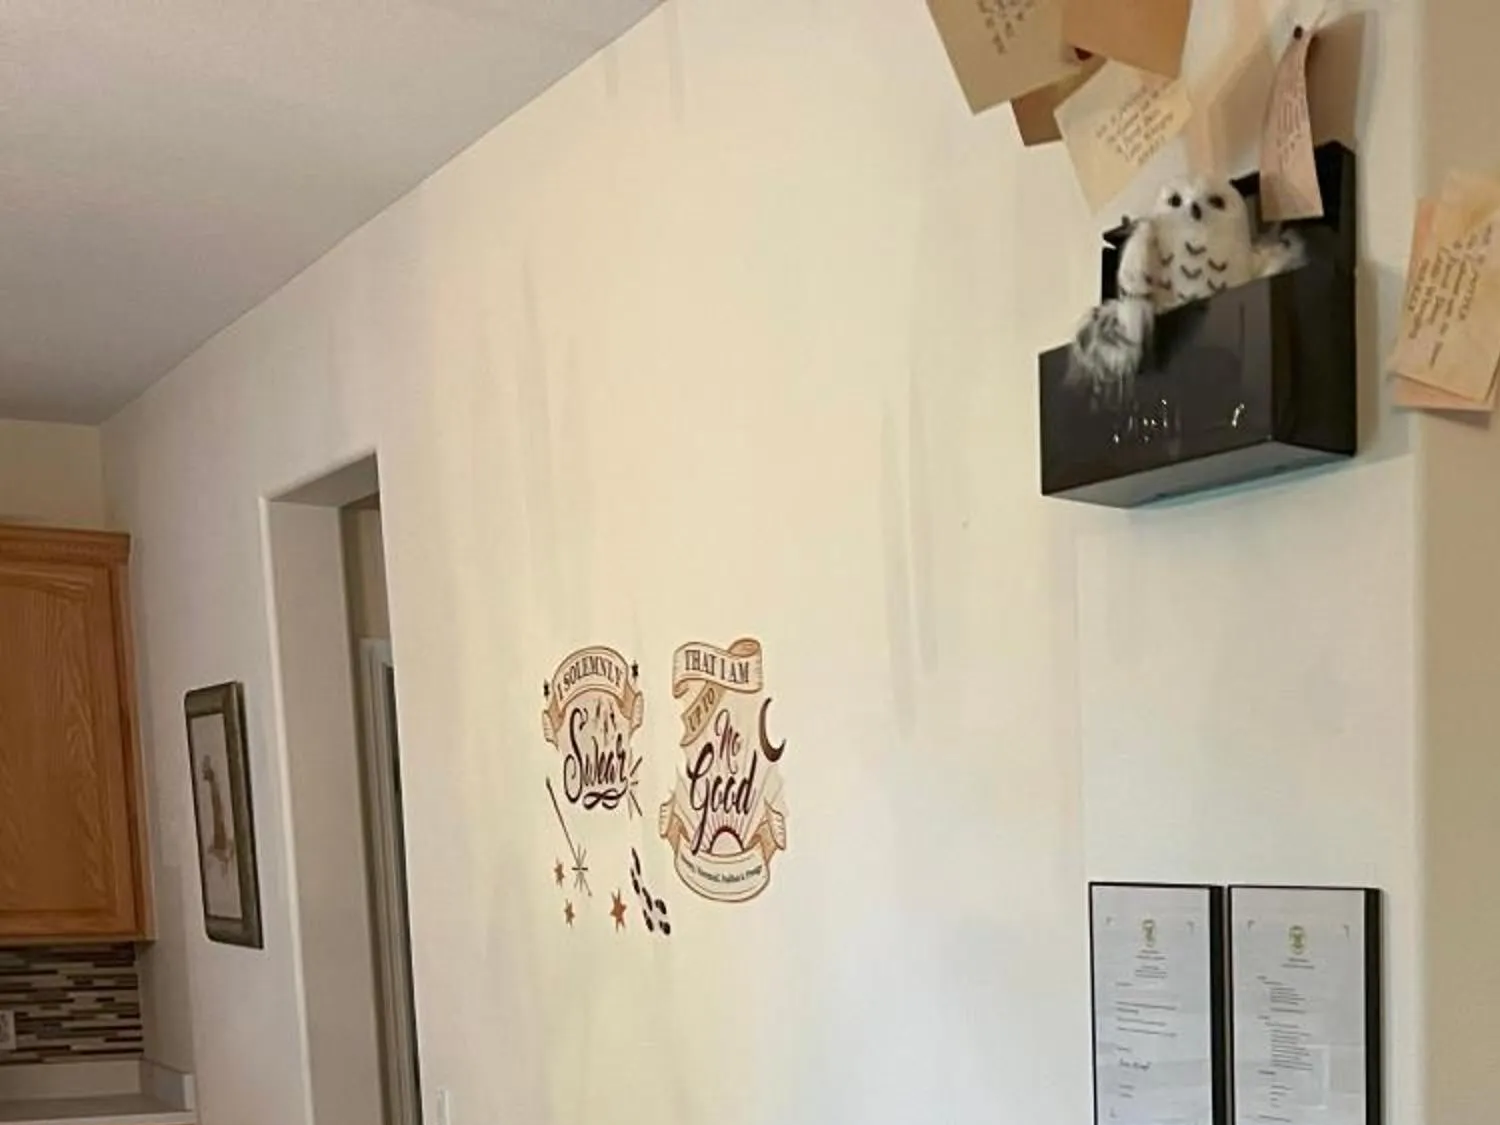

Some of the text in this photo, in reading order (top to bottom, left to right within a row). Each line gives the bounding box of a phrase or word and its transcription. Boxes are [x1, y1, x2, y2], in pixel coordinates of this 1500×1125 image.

[564, 655, 623, 691] SOLEMNLY
[684, 649, 750, 684] THAT I AM
[563, 707, 628, 811] Swear
[686, 742, 757, 855] Good
